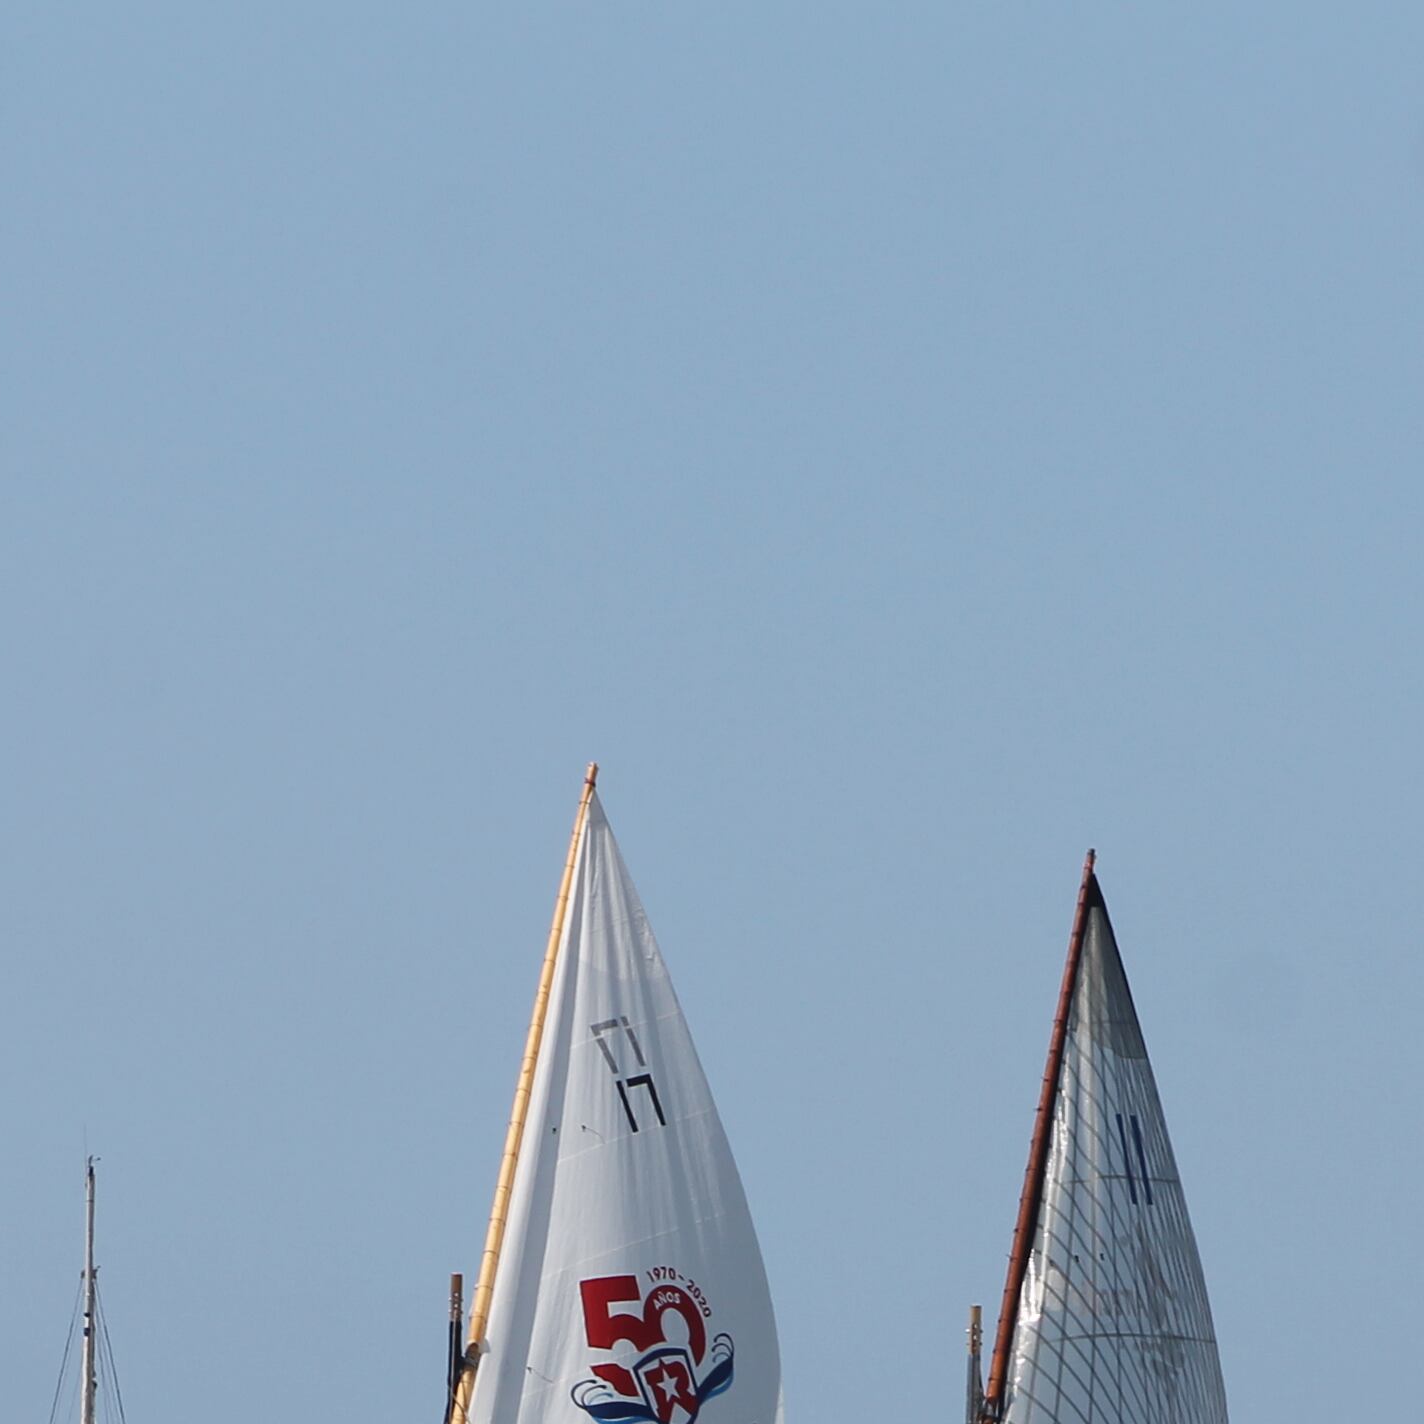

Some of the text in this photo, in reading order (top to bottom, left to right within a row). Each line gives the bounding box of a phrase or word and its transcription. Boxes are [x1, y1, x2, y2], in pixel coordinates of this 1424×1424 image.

[616, 1073, 667, 1134] 17
[1115, 1112, 1153, 1206] 11
[579, 1274, 707, 1398] 50
[653, 1290, 681, 1311] AÑOS
